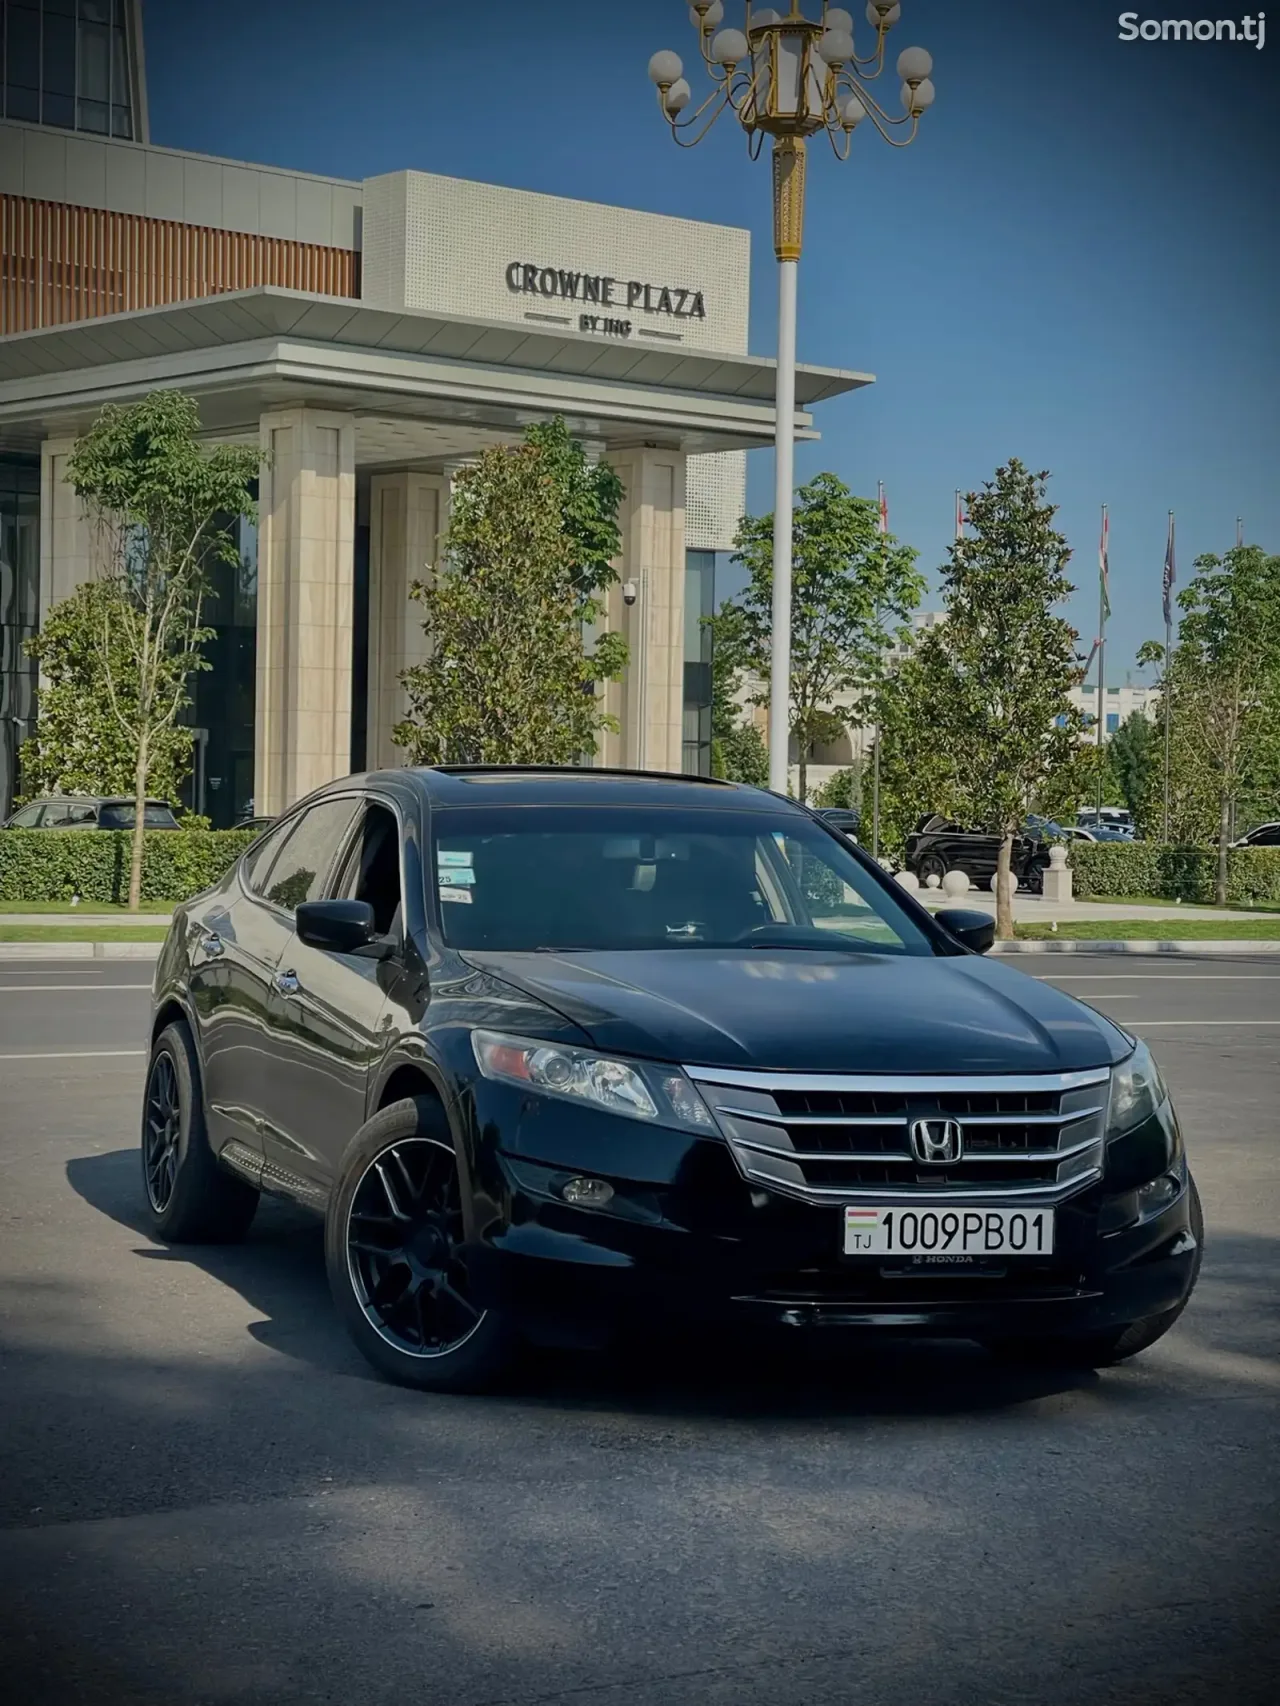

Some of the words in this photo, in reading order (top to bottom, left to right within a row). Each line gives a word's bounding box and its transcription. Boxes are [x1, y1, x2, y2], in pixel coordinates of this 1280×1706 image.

[505, 261, 615, 307] CROWNE
[627, 280, 706, 319] PLAZA
[580, 313, 600, 334] BY
[853, 1234, 872, 1249] TJ
[882, 1211, 1044, 1251] 1009PB01
[925, 1255, 974, 1264] HONDA
